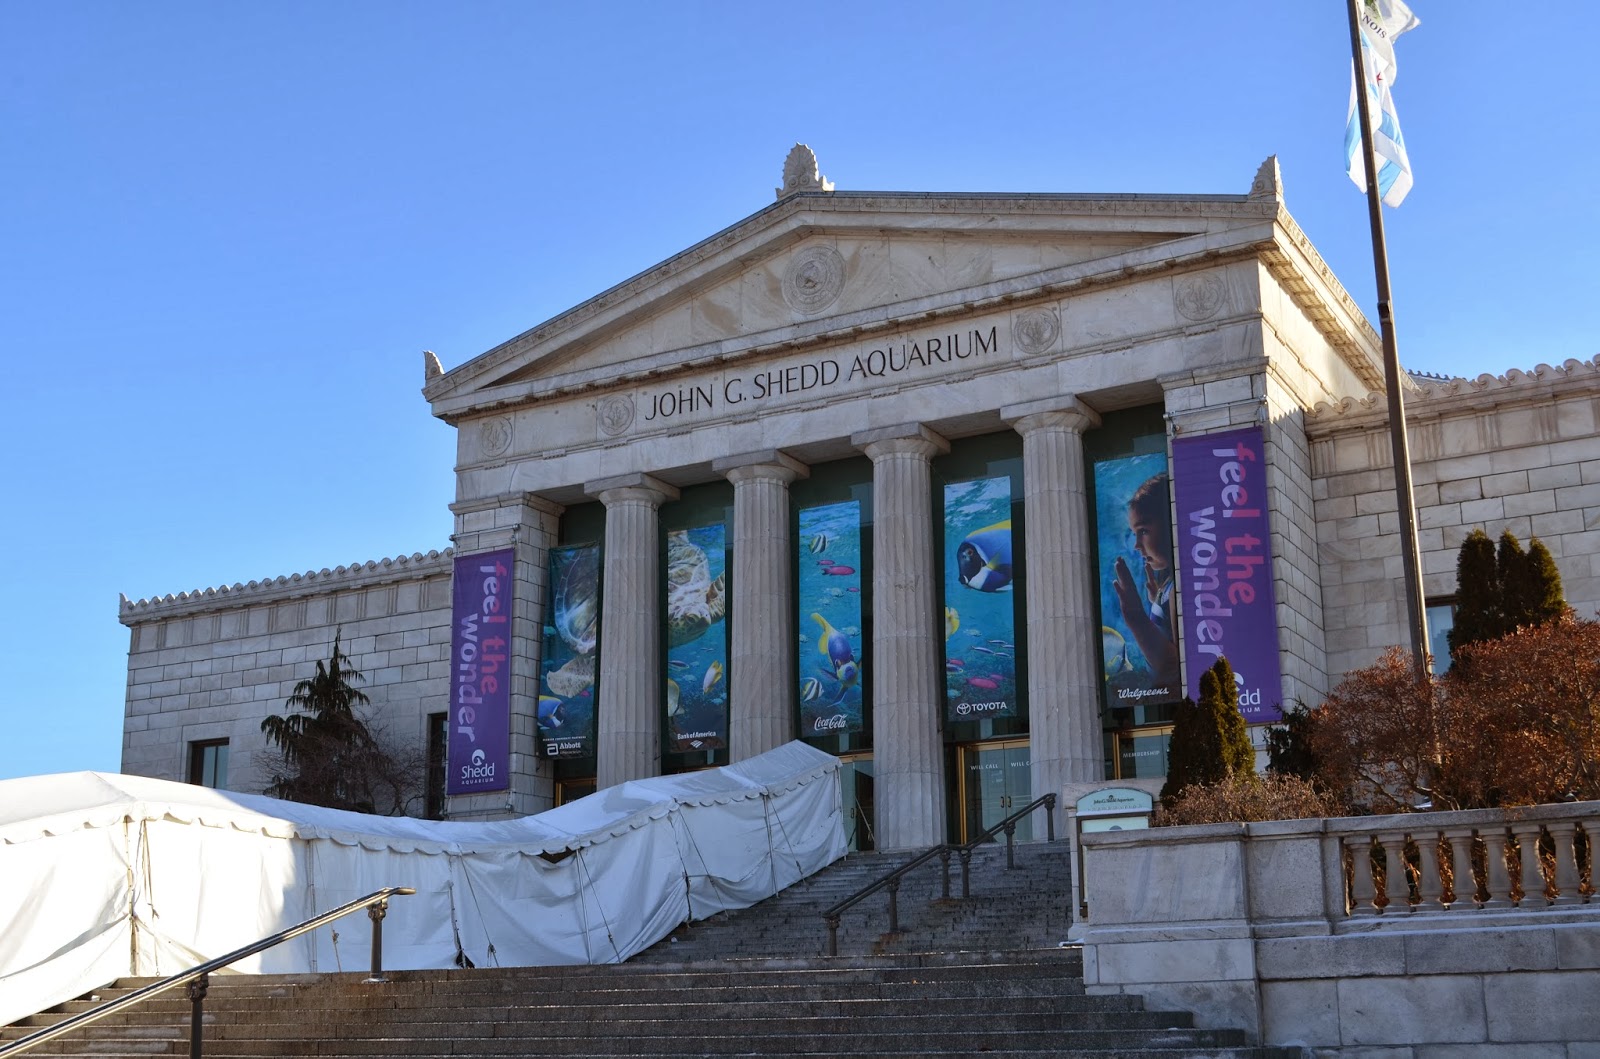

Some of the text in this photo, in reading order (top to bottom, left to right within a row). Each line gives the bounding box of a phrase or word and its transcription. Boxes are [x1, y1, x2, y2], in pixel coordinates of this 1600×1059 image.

[1362, 11, 1387, 39] NOIS
[644, 325, 999, 421] JOHN G. SHEDD AQUARIUM
[1212, 442, 1265, 605] feel the
[1189, 505, 1233, 660] wonder
[479, 559, 508, 696] feel the
[457, 612, 483, 744] wonder
[1117, 687, 1169, 701] Walgreens
[971, 701, 1008, 712] TOYOTA
[560, 742, 581, 750] Abbott
[695, 731, 717, 739] America
[461, 762, 495, 779] Shedd
[461, 777, 494, 785] AQUARIUM
